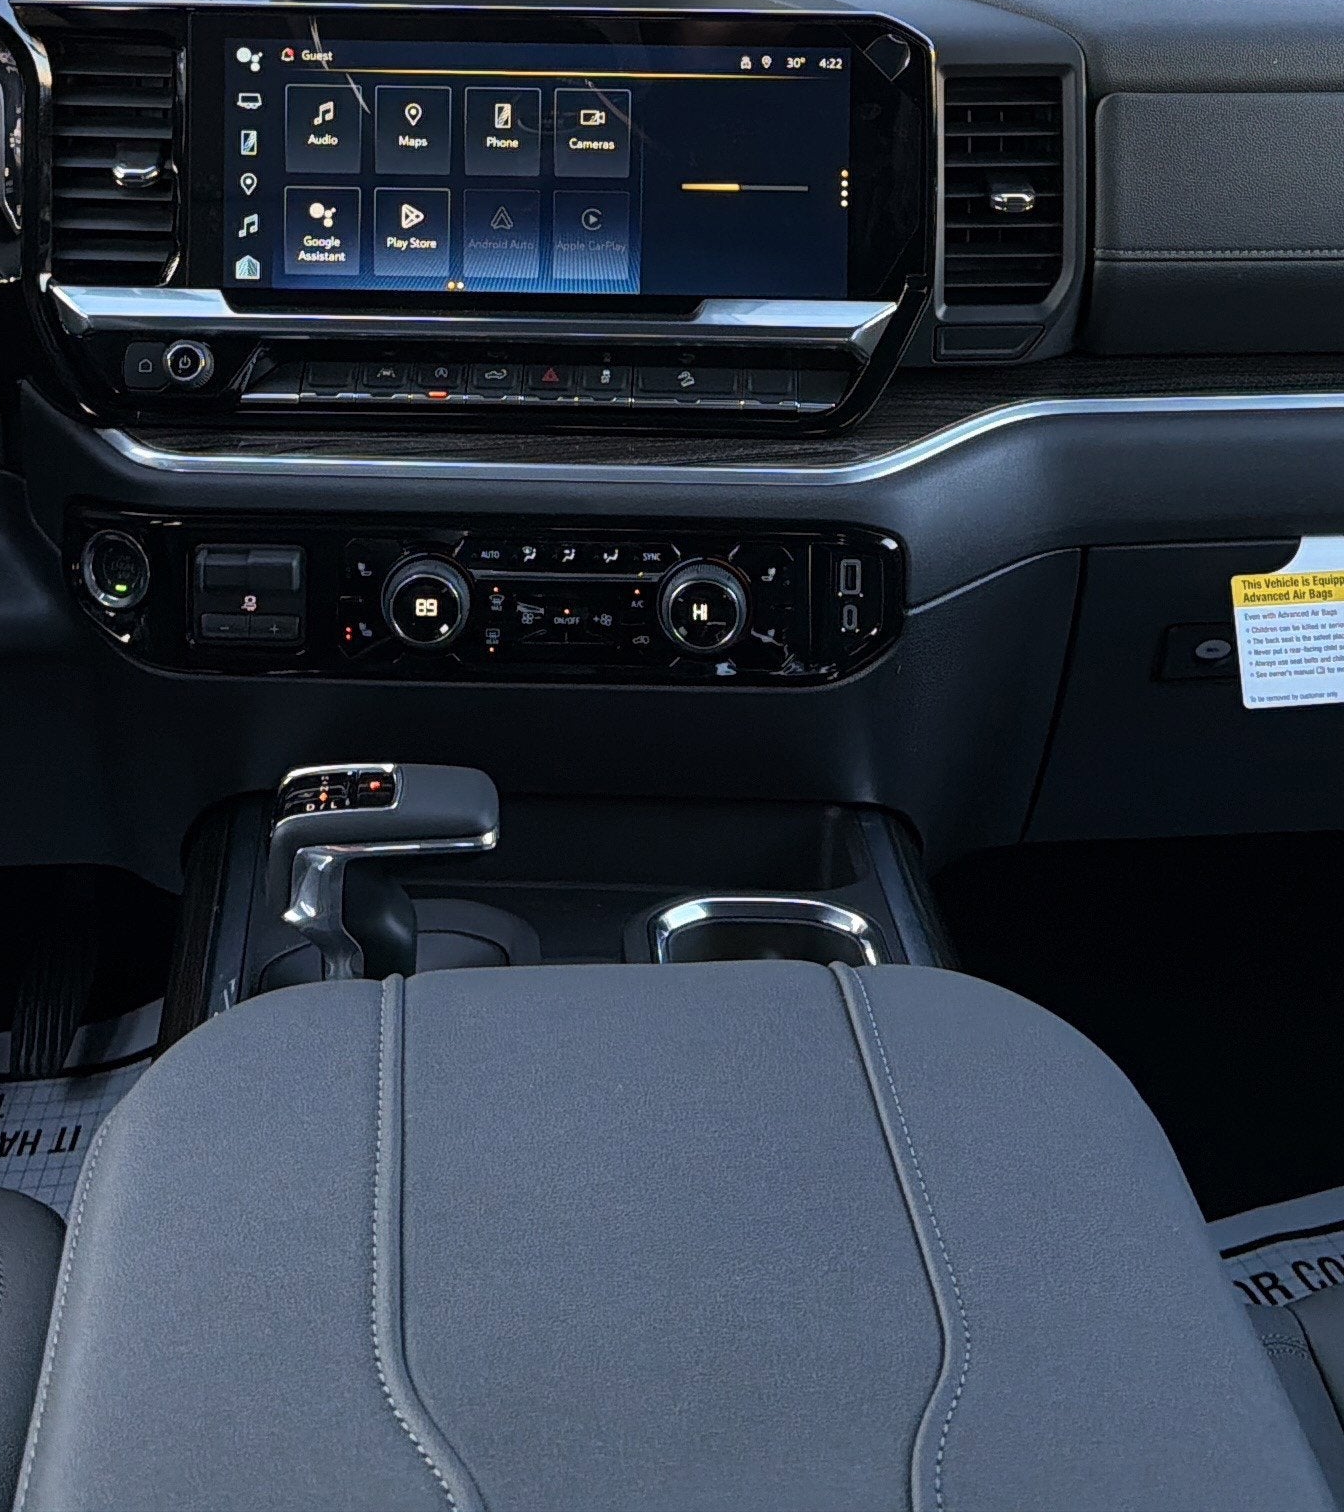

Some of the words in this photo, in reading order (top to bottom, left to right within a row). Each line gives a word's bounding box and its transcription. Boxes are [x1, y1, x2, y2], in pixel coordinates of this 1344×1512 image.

[301, 49, 333, 61] Guest
[786, 56, 806, 69] 30°
[818, 57, 843, 70] 4:22
[308, 134, 338, 145] Audio
[398, 135, 428, 148] Maps
[486, 136, 519, 148] Phone
[568, 138, 615, 149] Cameras
[303, 235, 341, 248] Google
[386, 237, 408, 251] Play
[410, 237, 437, 249] Store
[468, 239, 508, 250] Android
[509, 240, 534, 250] Auto
[556, 240, 586, 253] Apple
[588, 240, 627, 253] CarPlay
[298, 250, 346, 262] Assistant
[480, 550, 500, 560] AUTO
[642, 552, 662, 562] SYNC
[1241, 579, 1262, 591] This
[1264, 577, 1299, 588] Vehicle
[1301, 576, 1310, 587] is
[1243, 592, 1290, 603] Advanced
[1293, 590, 1306, 600] Air
[1309, 589, 1333, 602] Bags
[415, 598, 438, 616] 89
[630, 600, 644, 609] A/C
[692, 603, 708, 621] HI
[1278, 609, 1309, 619] Advanced
[1311, 609, 1320, 617] Air
[1321, 608, 1337, 617] Bags
[554, 616, 580, 625] ON/OFF
[1251, 625, 1278, 633] Children
[1256, 670, 1267, 679] See
[47, 1125, 83, 1152] IT
